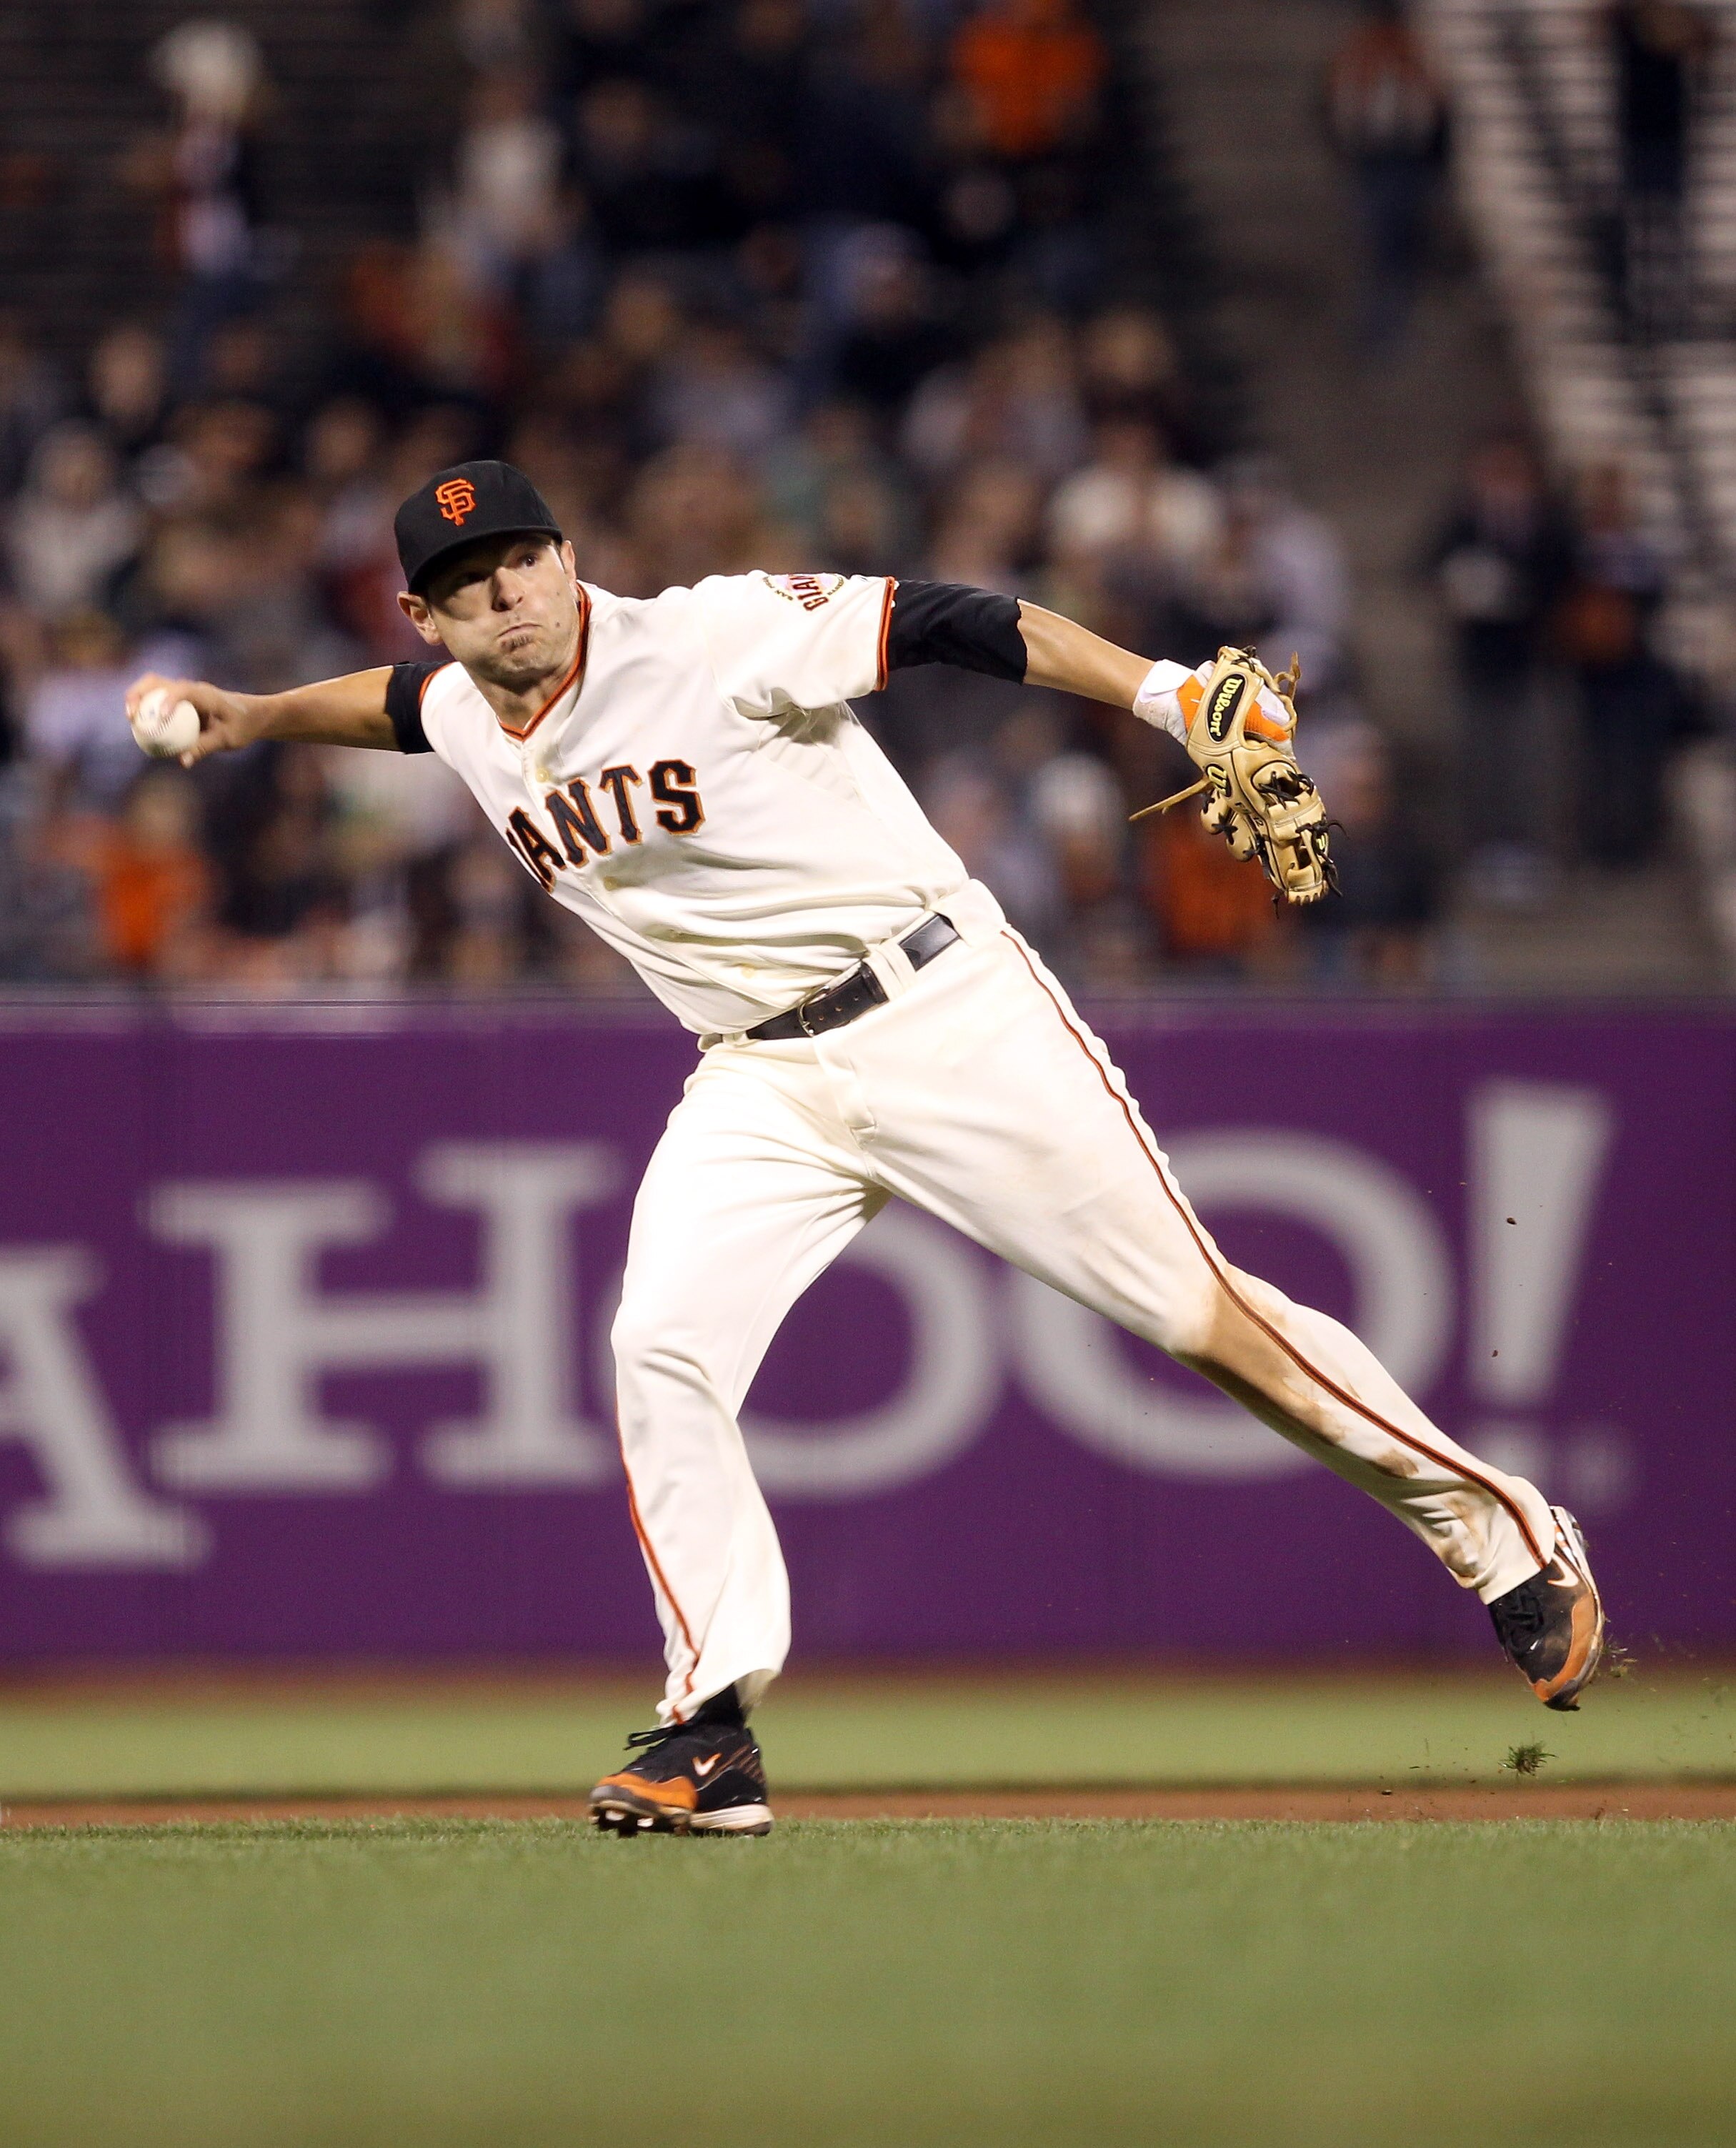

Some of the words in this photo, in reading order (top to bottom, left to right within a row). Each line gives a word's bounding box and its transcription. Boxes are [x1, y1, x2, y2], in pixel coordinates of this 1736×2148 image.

[434, 477, 477, 526] SF
[789, 575, 829, 612] GIA
[1210, 678, 1242, 737] Wilson
[506, 759, 707, 894] ANTS
